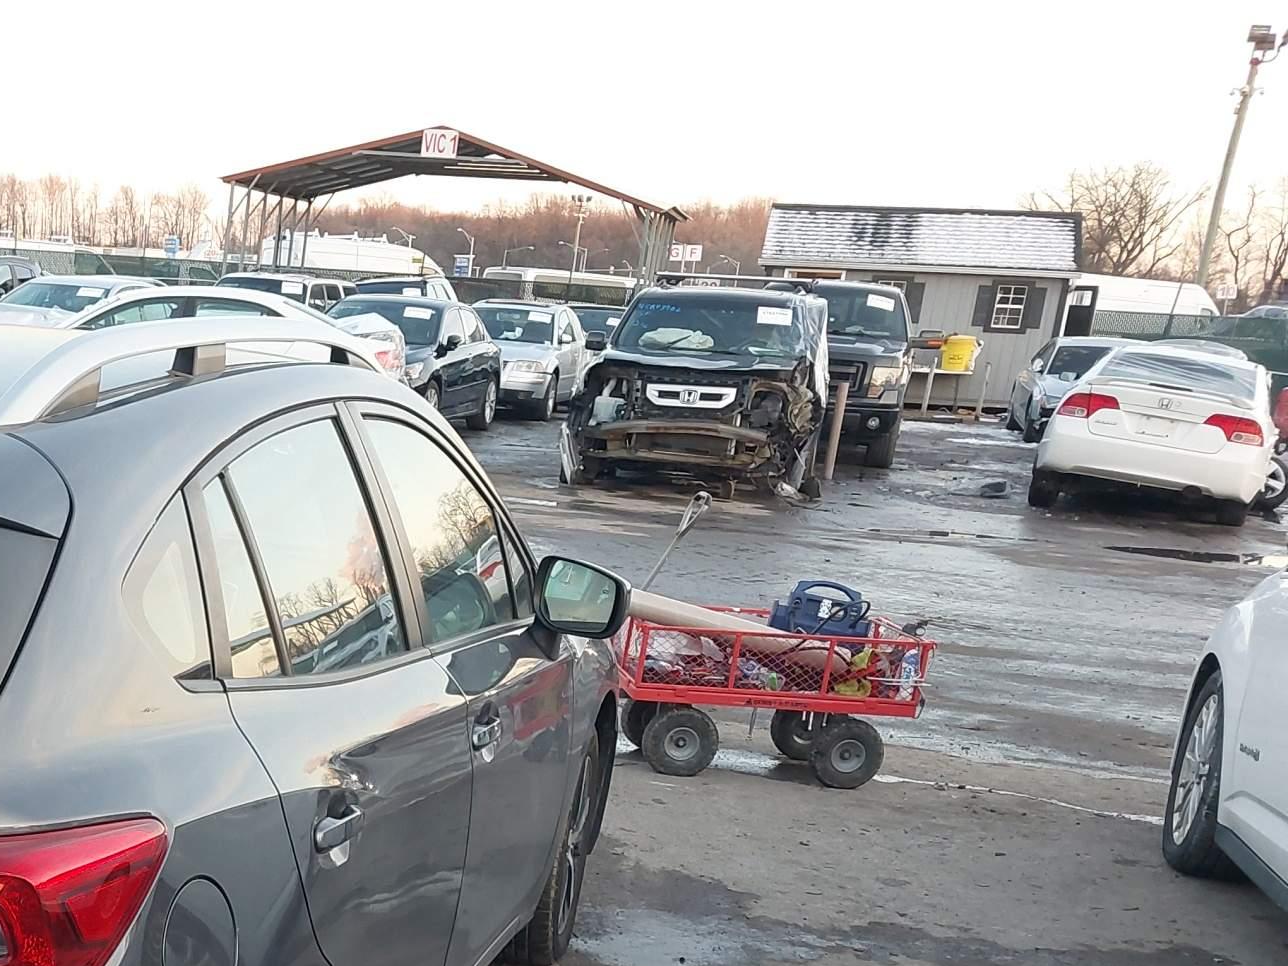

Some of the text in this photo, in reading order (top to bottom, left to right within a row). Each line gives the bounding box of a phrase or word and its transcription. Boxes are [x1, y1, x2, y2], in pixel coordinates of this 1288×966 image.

[424, 132, 458, 155] VIC 1
[671, 247, 680, 258] G
[689, 247, 697, 258] F
